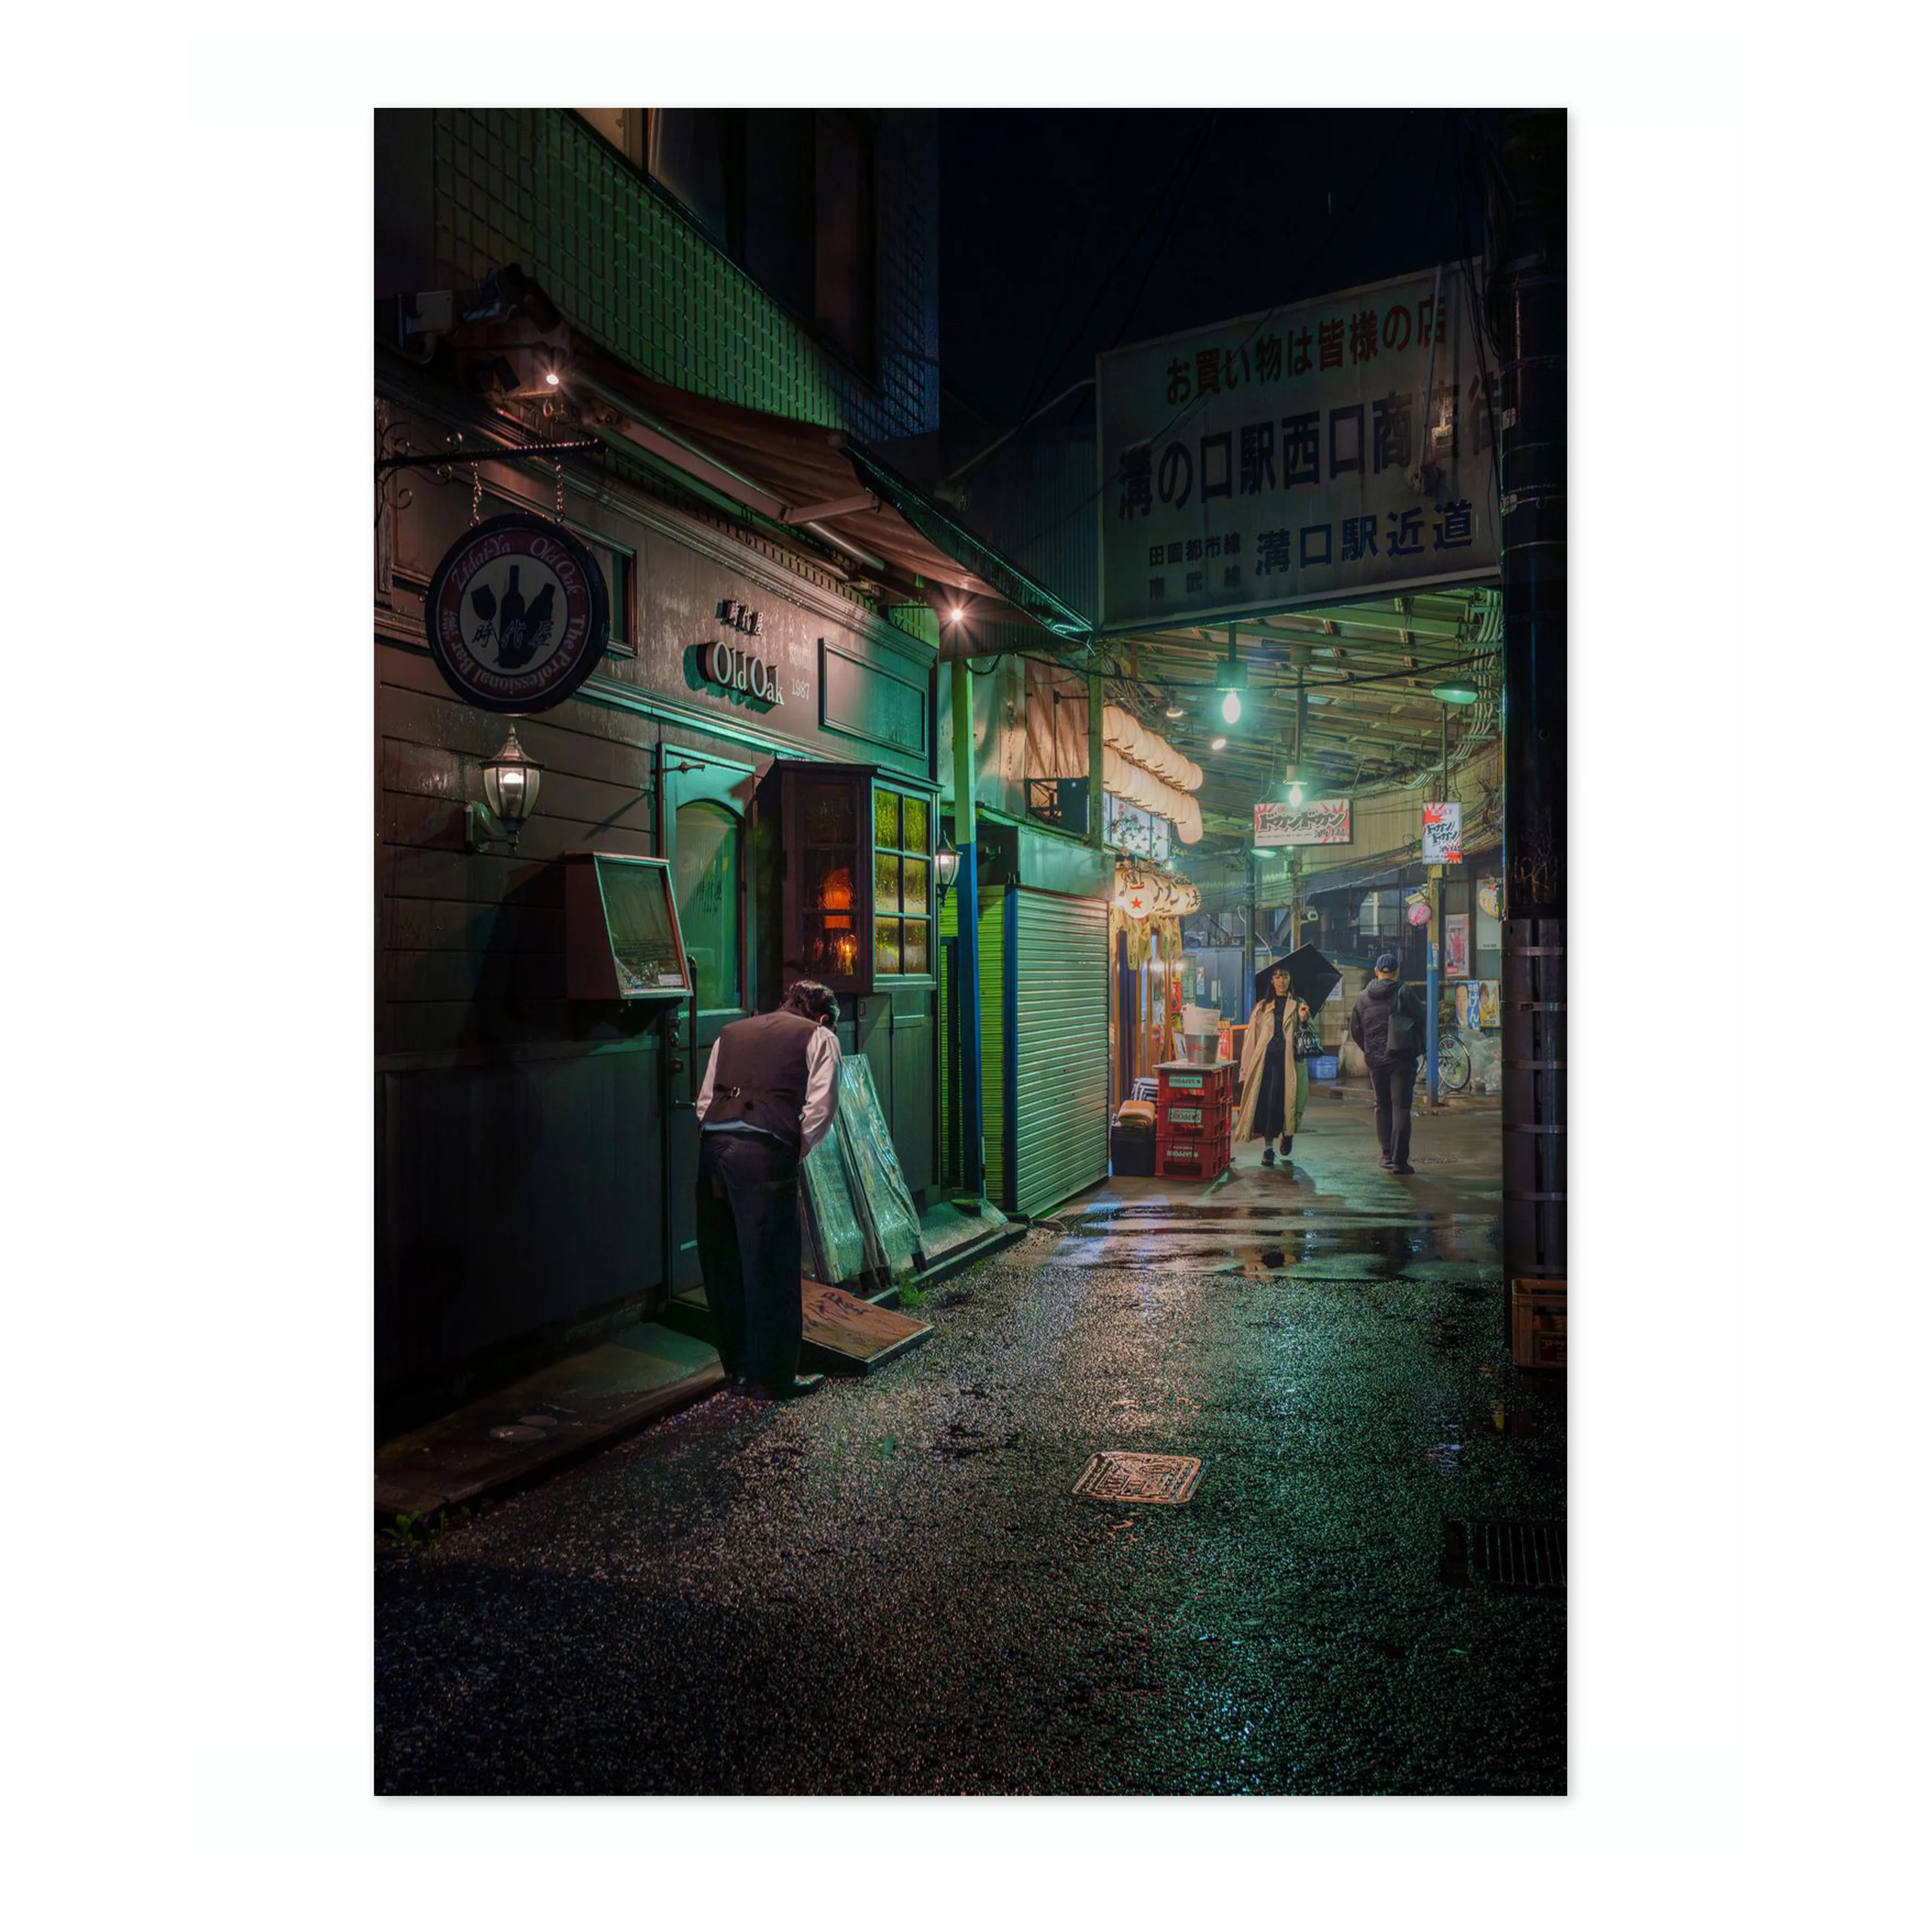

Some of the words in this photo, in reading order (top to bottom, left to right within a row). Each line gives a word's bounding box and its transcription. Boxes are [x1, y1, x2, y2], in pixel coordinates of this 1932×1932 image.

[1166, 294, 1446, 405] お買い物は皆様の店
[1256, 500, 1473, 576] 溝口駅近道
[530, 537, 568, 565] Old
[555, 561, 586, 596] Oak
[564, 614, 586, 649] The
[451, 642, 475, 675] Bar
[472, 650, 572, 695] Professional
[713, 641, 748, 692] Old
[750, 656, 785, 705] Oak
[791, 678, 810, 700] 1987
